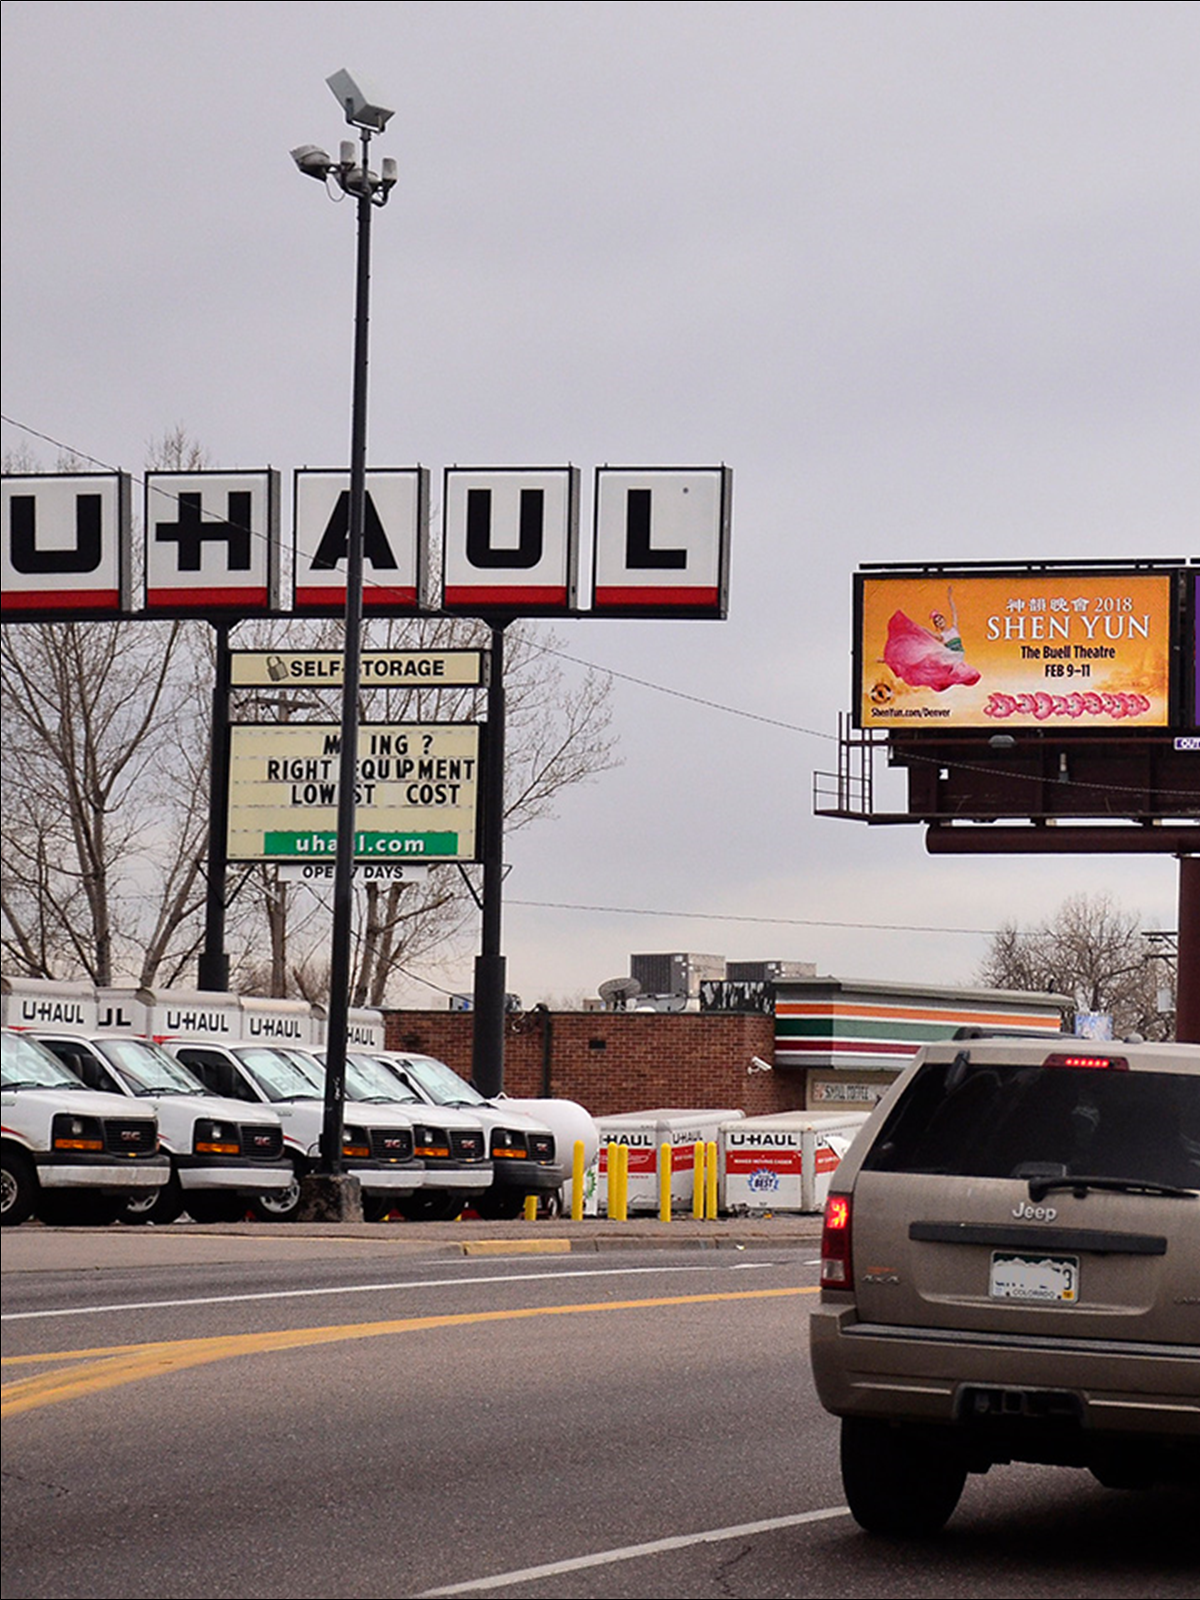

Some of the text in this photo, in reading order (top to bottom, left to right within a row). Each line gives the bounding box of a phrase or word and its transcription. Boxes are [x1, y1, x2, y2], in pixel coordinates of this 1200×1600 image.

[1094, 597, 1133, 612] 2018
[986, 614, 1150, 640] SHEN YUN
[1020, 645, 1116, 659] The Buell Theatre
[290, 659, 445, 677] SELF-TORAGE
[1045, 664, 1065, 677] FEB
[871, 707, 951, 718] ShenYun.com/Denver
[323, 735, 408, 755] MING
[267, 759, 476, 780] RIGHT QUIPMENT
[291, 784, 461, 804] LOWST COST
[296, 835, 425, 853] uhal.com
[302, 866, 334, 879] OPE
[364, 866, 403, 879] DAYS
[166, 1010, 229, 1032] U-HAUL
[250, 1018, 302, 1038] U-HAUL
[347, 1026, 375, 1046] HAUL
[730, 1134, 797, 1146] U-HAUL
[754, 1178, 774, 1188] BEST
[1012, 1202, 1057, 1222] Jeep
